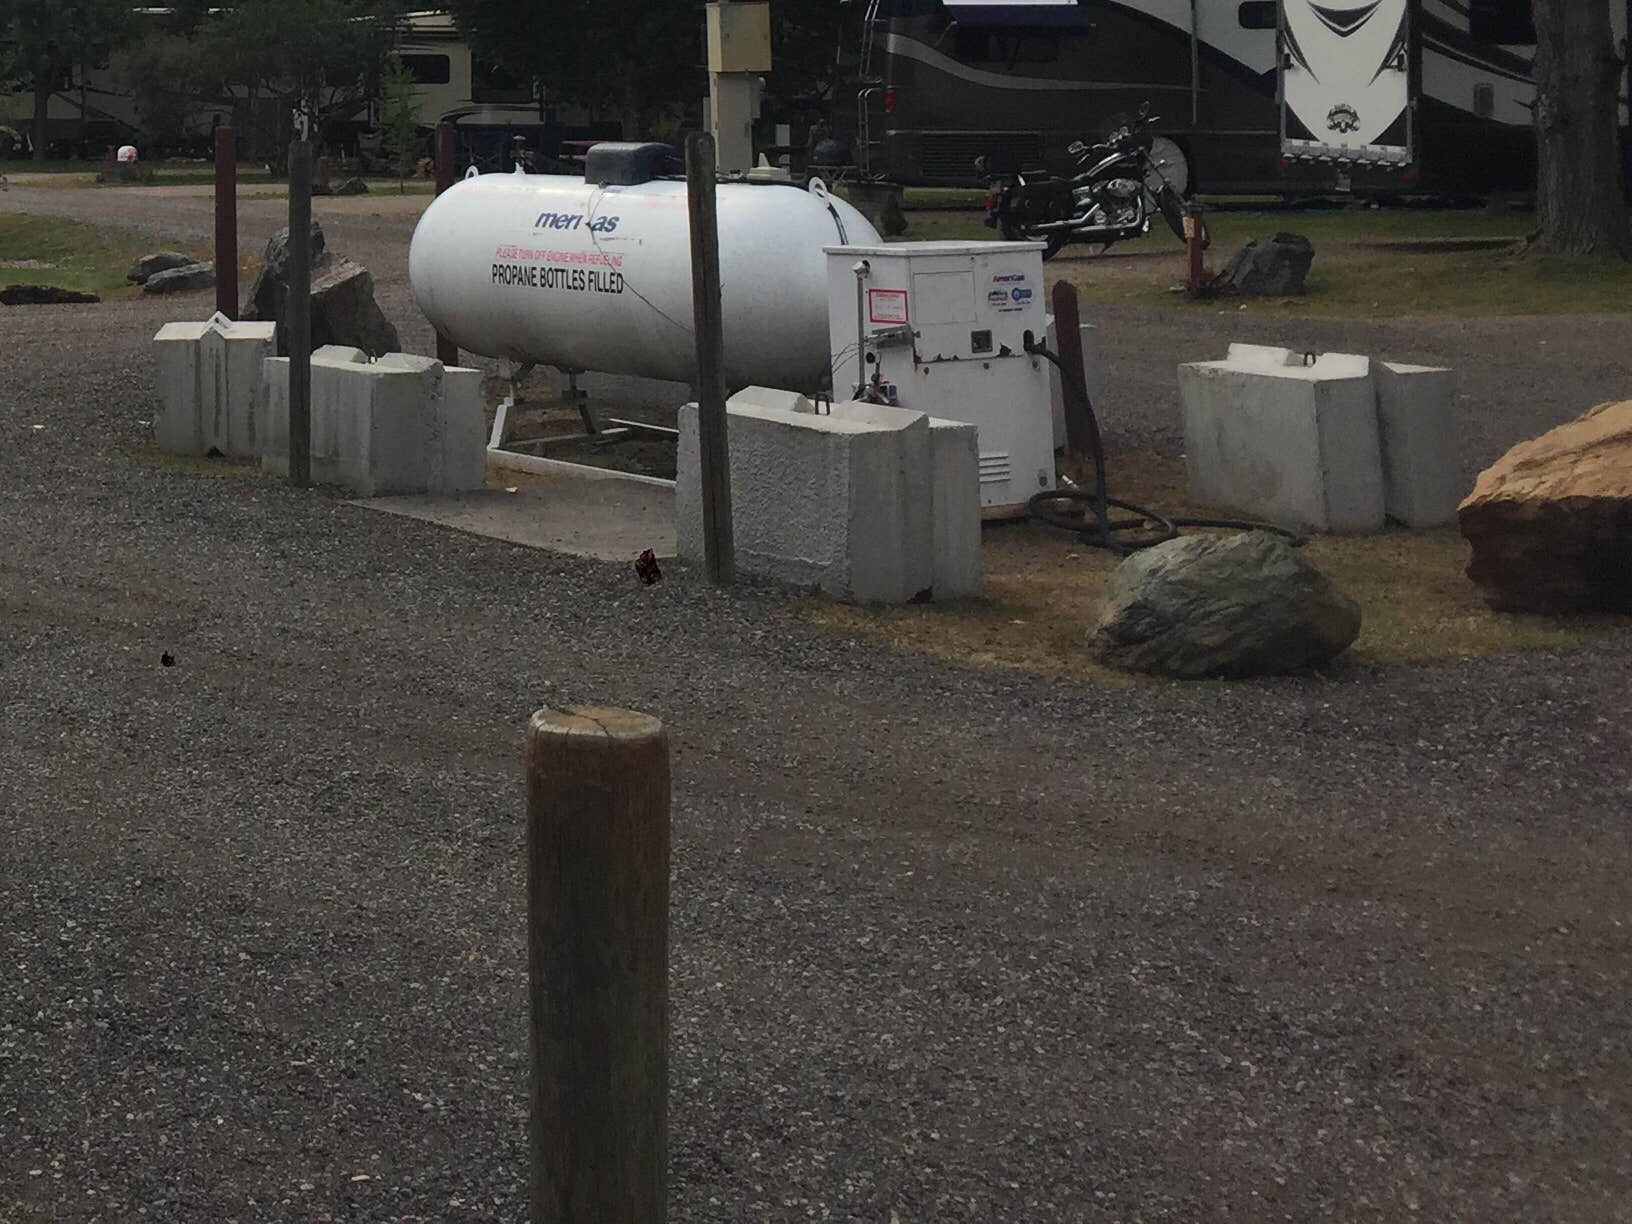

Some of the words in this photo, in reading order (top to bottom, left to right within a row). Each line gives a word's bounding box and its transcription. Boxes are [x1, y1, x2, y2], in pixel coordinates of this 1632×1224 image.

[492, 264, 537, 287] PROPANE
[540, 267, 585, 291] BOTTLES
[588, 271, 624, 294] FILLED
